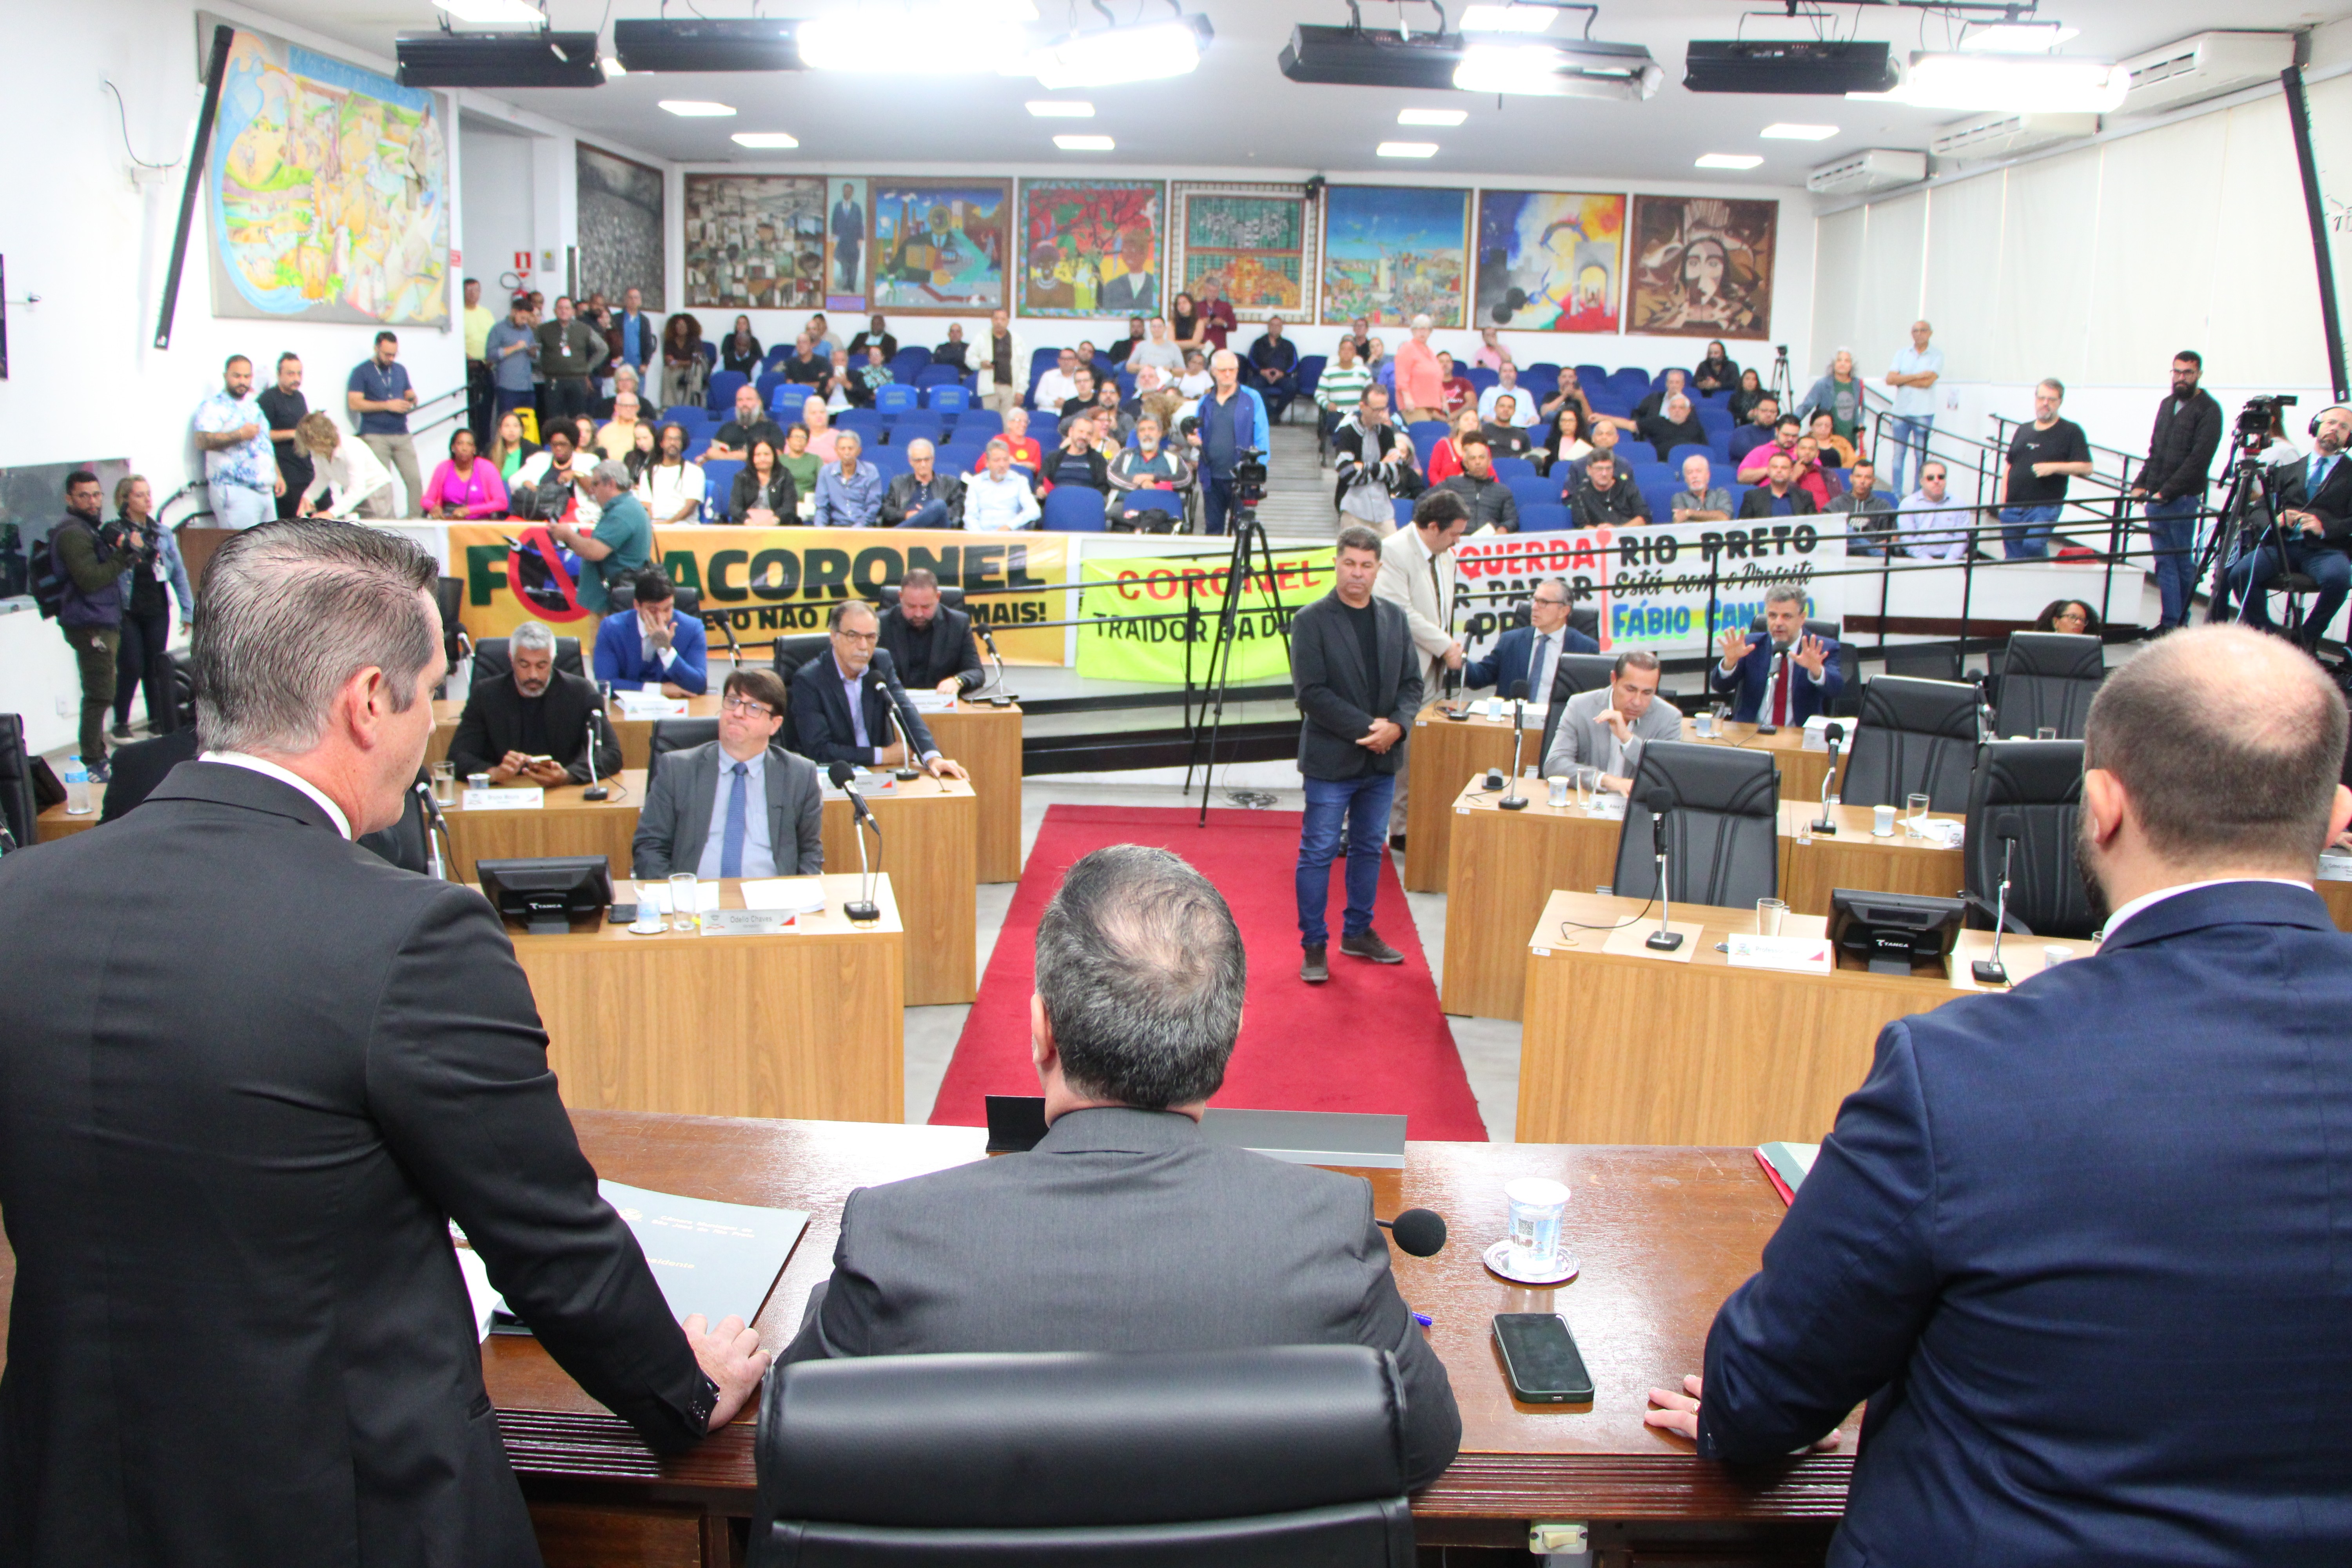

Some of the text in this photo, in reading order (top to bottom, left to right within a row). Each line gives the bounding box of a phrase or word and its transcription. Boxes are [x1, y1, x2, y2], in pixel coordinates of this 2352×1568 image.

[1450, 537, 1595, 580] QUERDA
[1619, 524, 1817, 567] RIO PRETO
[707, 544, 1045, 601] CORONEL
[1117, 560, 1321, 600] CORONEL
[964, 602, 1047, 623] MAIS!
[1093, 613, 1207, 642] TRAIDOR
[1612, 599, 1690, 640] FÁBIO
